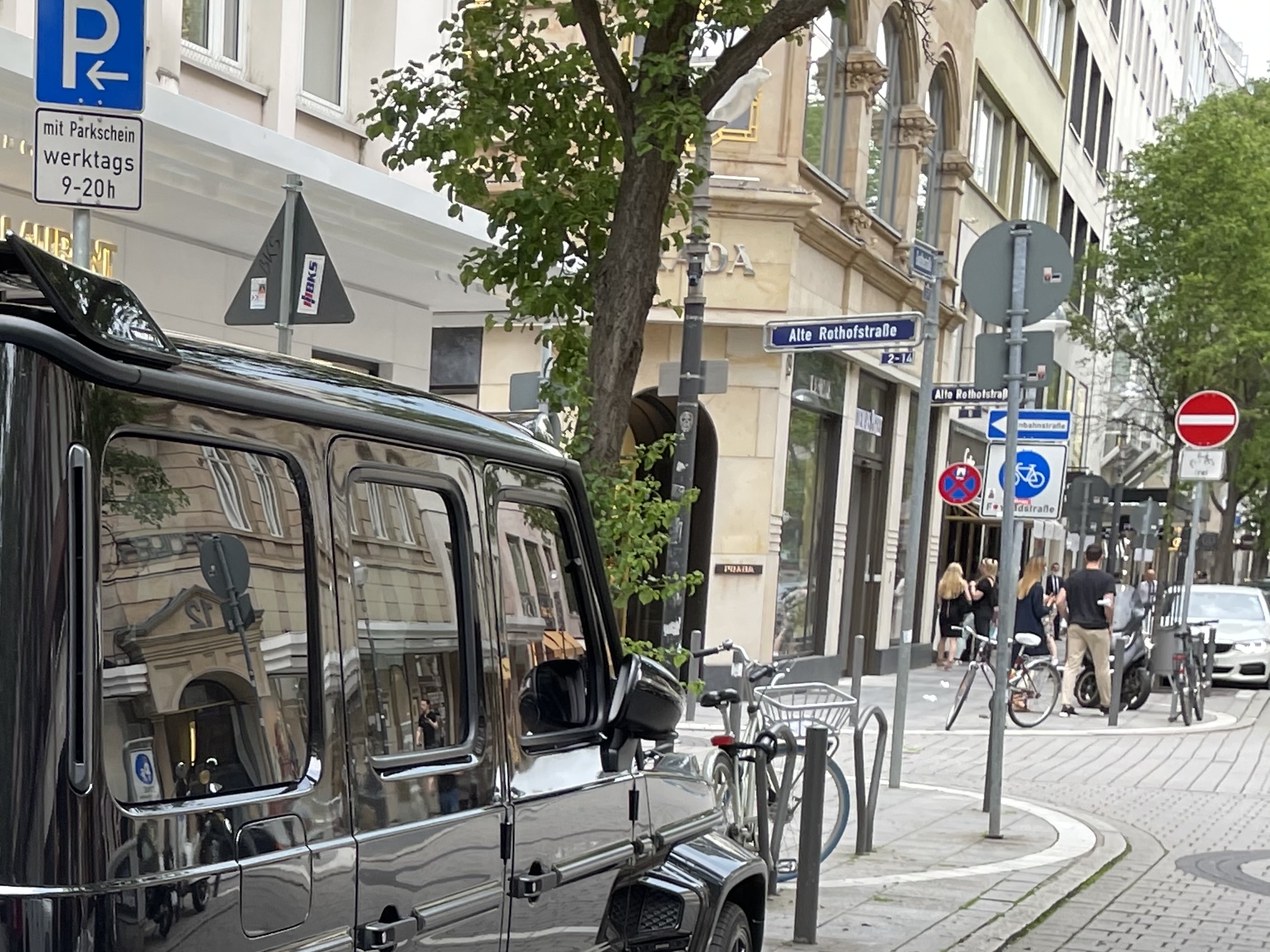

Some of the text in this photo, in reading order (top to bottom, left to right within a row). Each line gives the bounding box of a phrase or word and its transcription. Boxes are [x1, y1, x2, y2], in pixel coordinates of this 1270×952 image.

[62, 0, 120, 89] P
[43, 121, 135, 143] mit Parkschein
[43, 149, 135, 175] werktags
[1, 216, 118, 277] LAURNT
[305, 261, 318, 294] BKS
[788, 323, 898, 343] Alte Rothofstraße
[887, 353, 913, 364] 2-14
[935, 388, 1009, 401] Alte Rothofstraß
[1019, 420, 1066, 430] nbahnstraße
